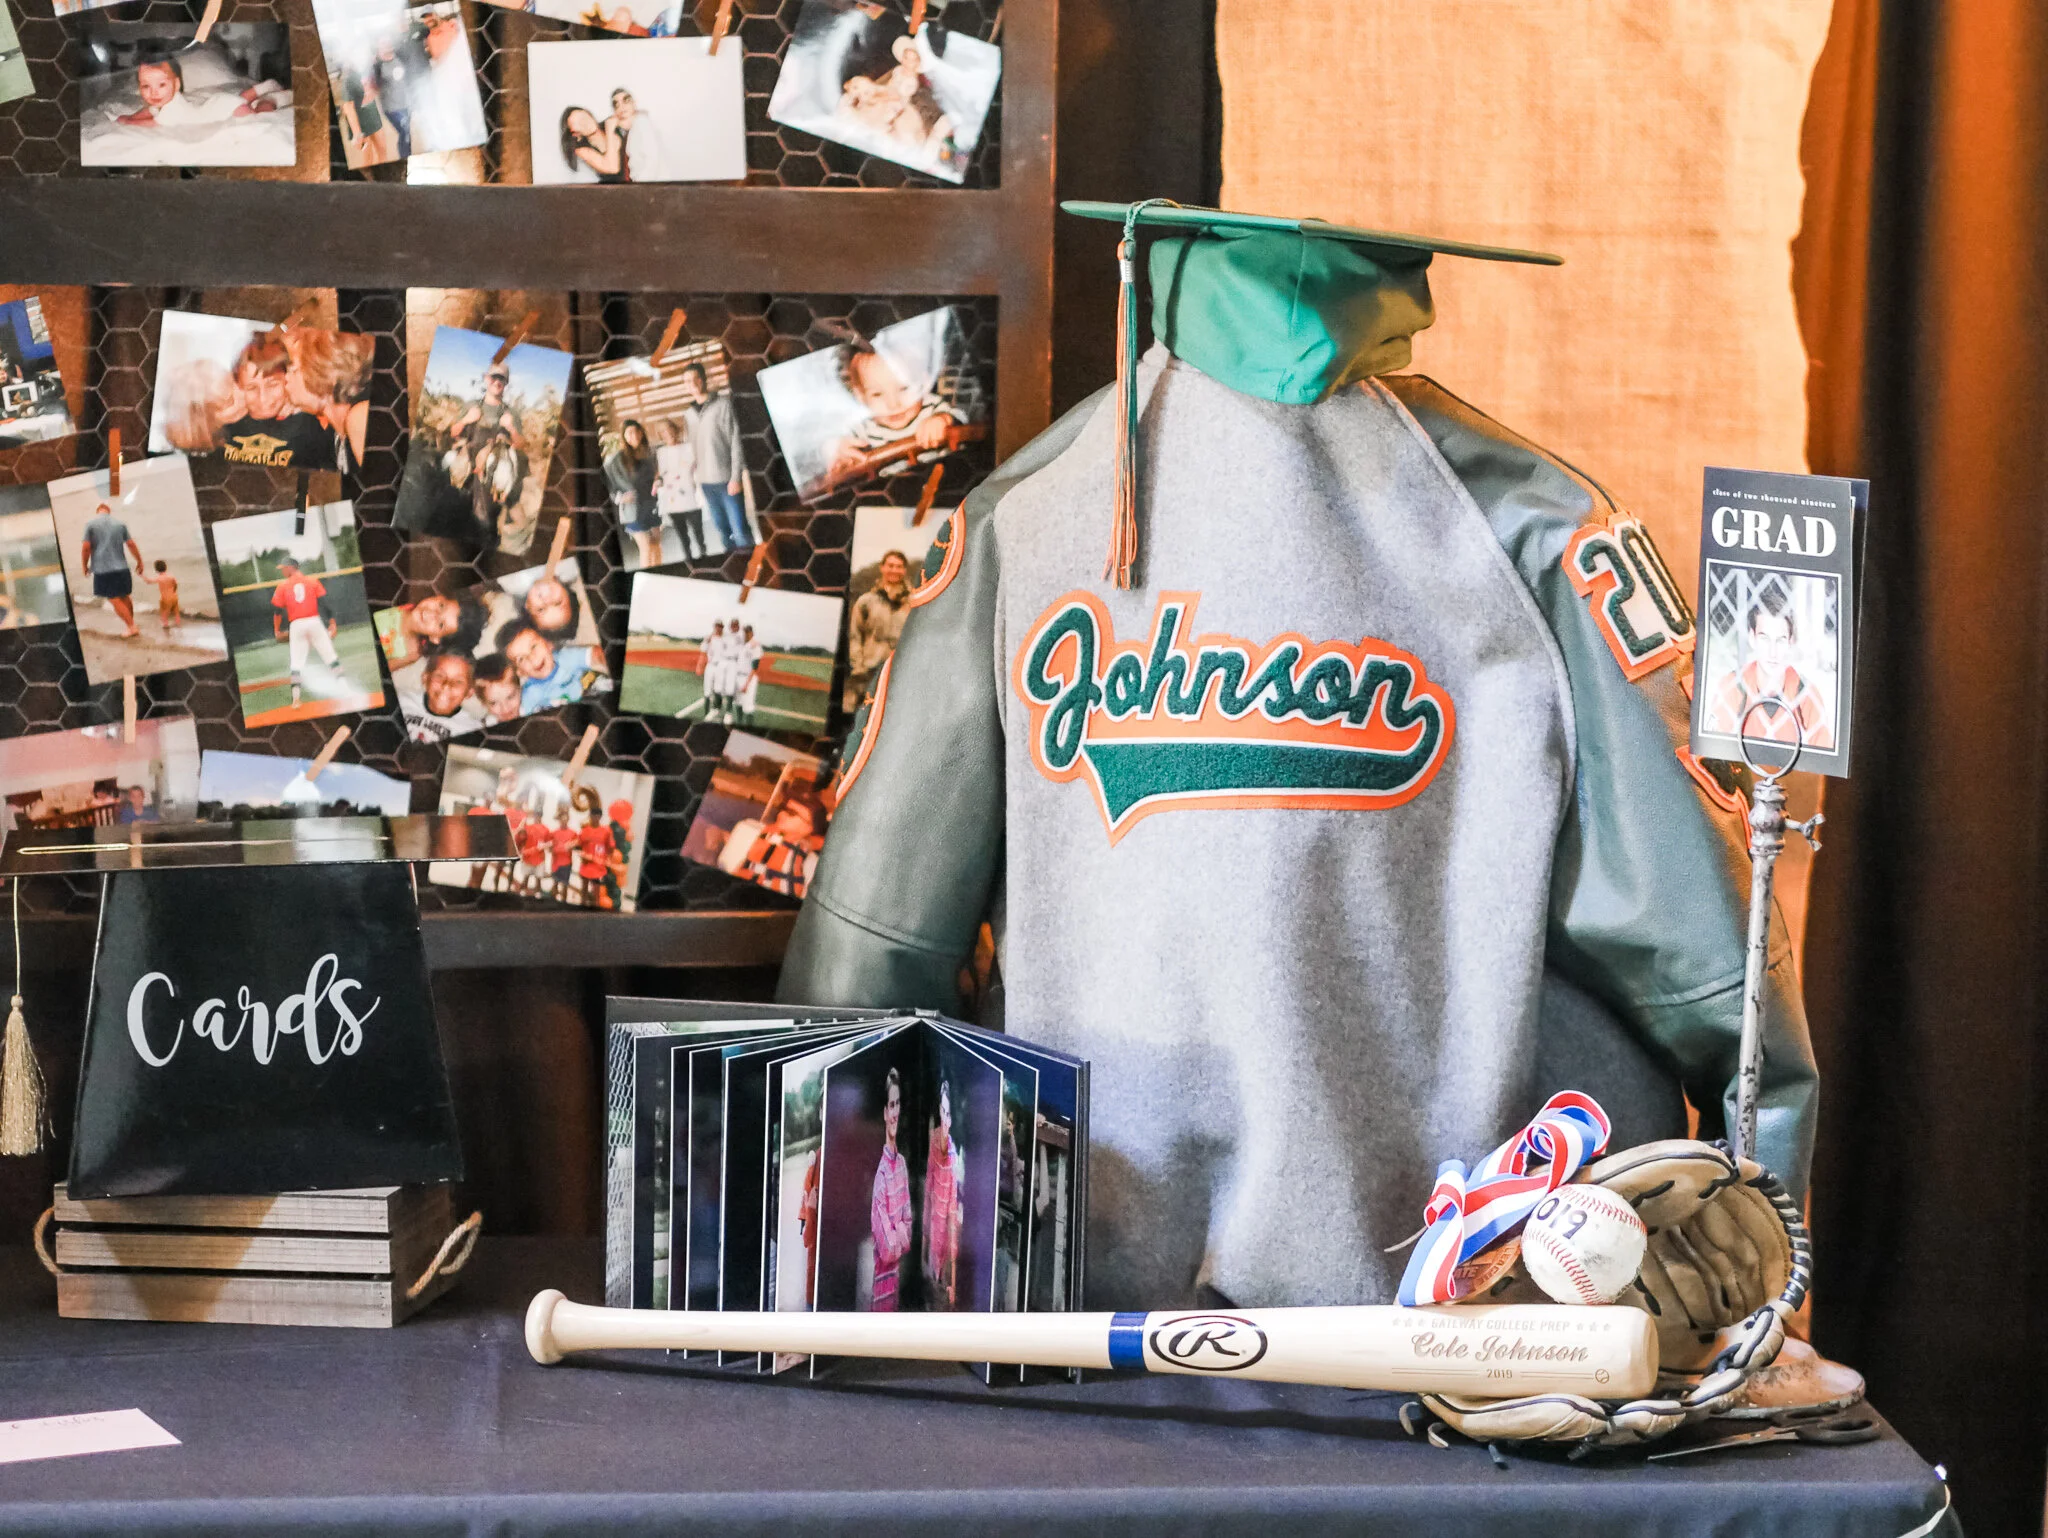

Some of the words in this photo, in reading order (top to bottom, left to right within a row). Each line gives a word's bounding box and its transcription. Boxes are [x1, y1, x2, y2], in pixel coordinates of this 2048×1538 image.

[1712, 488, 1730, 497] class
[1732, 490, 1742, 499] of
[1744, 492, 1758, 501] two
[1760, 493, 1798, 505] thousand
[1800, 497, 1837, 509] nineteen
[1711, 505, 1837, 558] GRAD
[1020, 600, 1444, 774] Johnson
[127, 953, 381, 1067] Cards
[1430, 1317, 1483, 1331] GATEWAY
[1486, 1319, 1537, 1332] COLLEGE
[1540, 1321, 1570, 1333] PREP
[1411, 1331, 1469, 1359] Cole
[1474, 1333, 1589, 1363] Johnson
[1485, 1368, 1514, 1380] 2019
